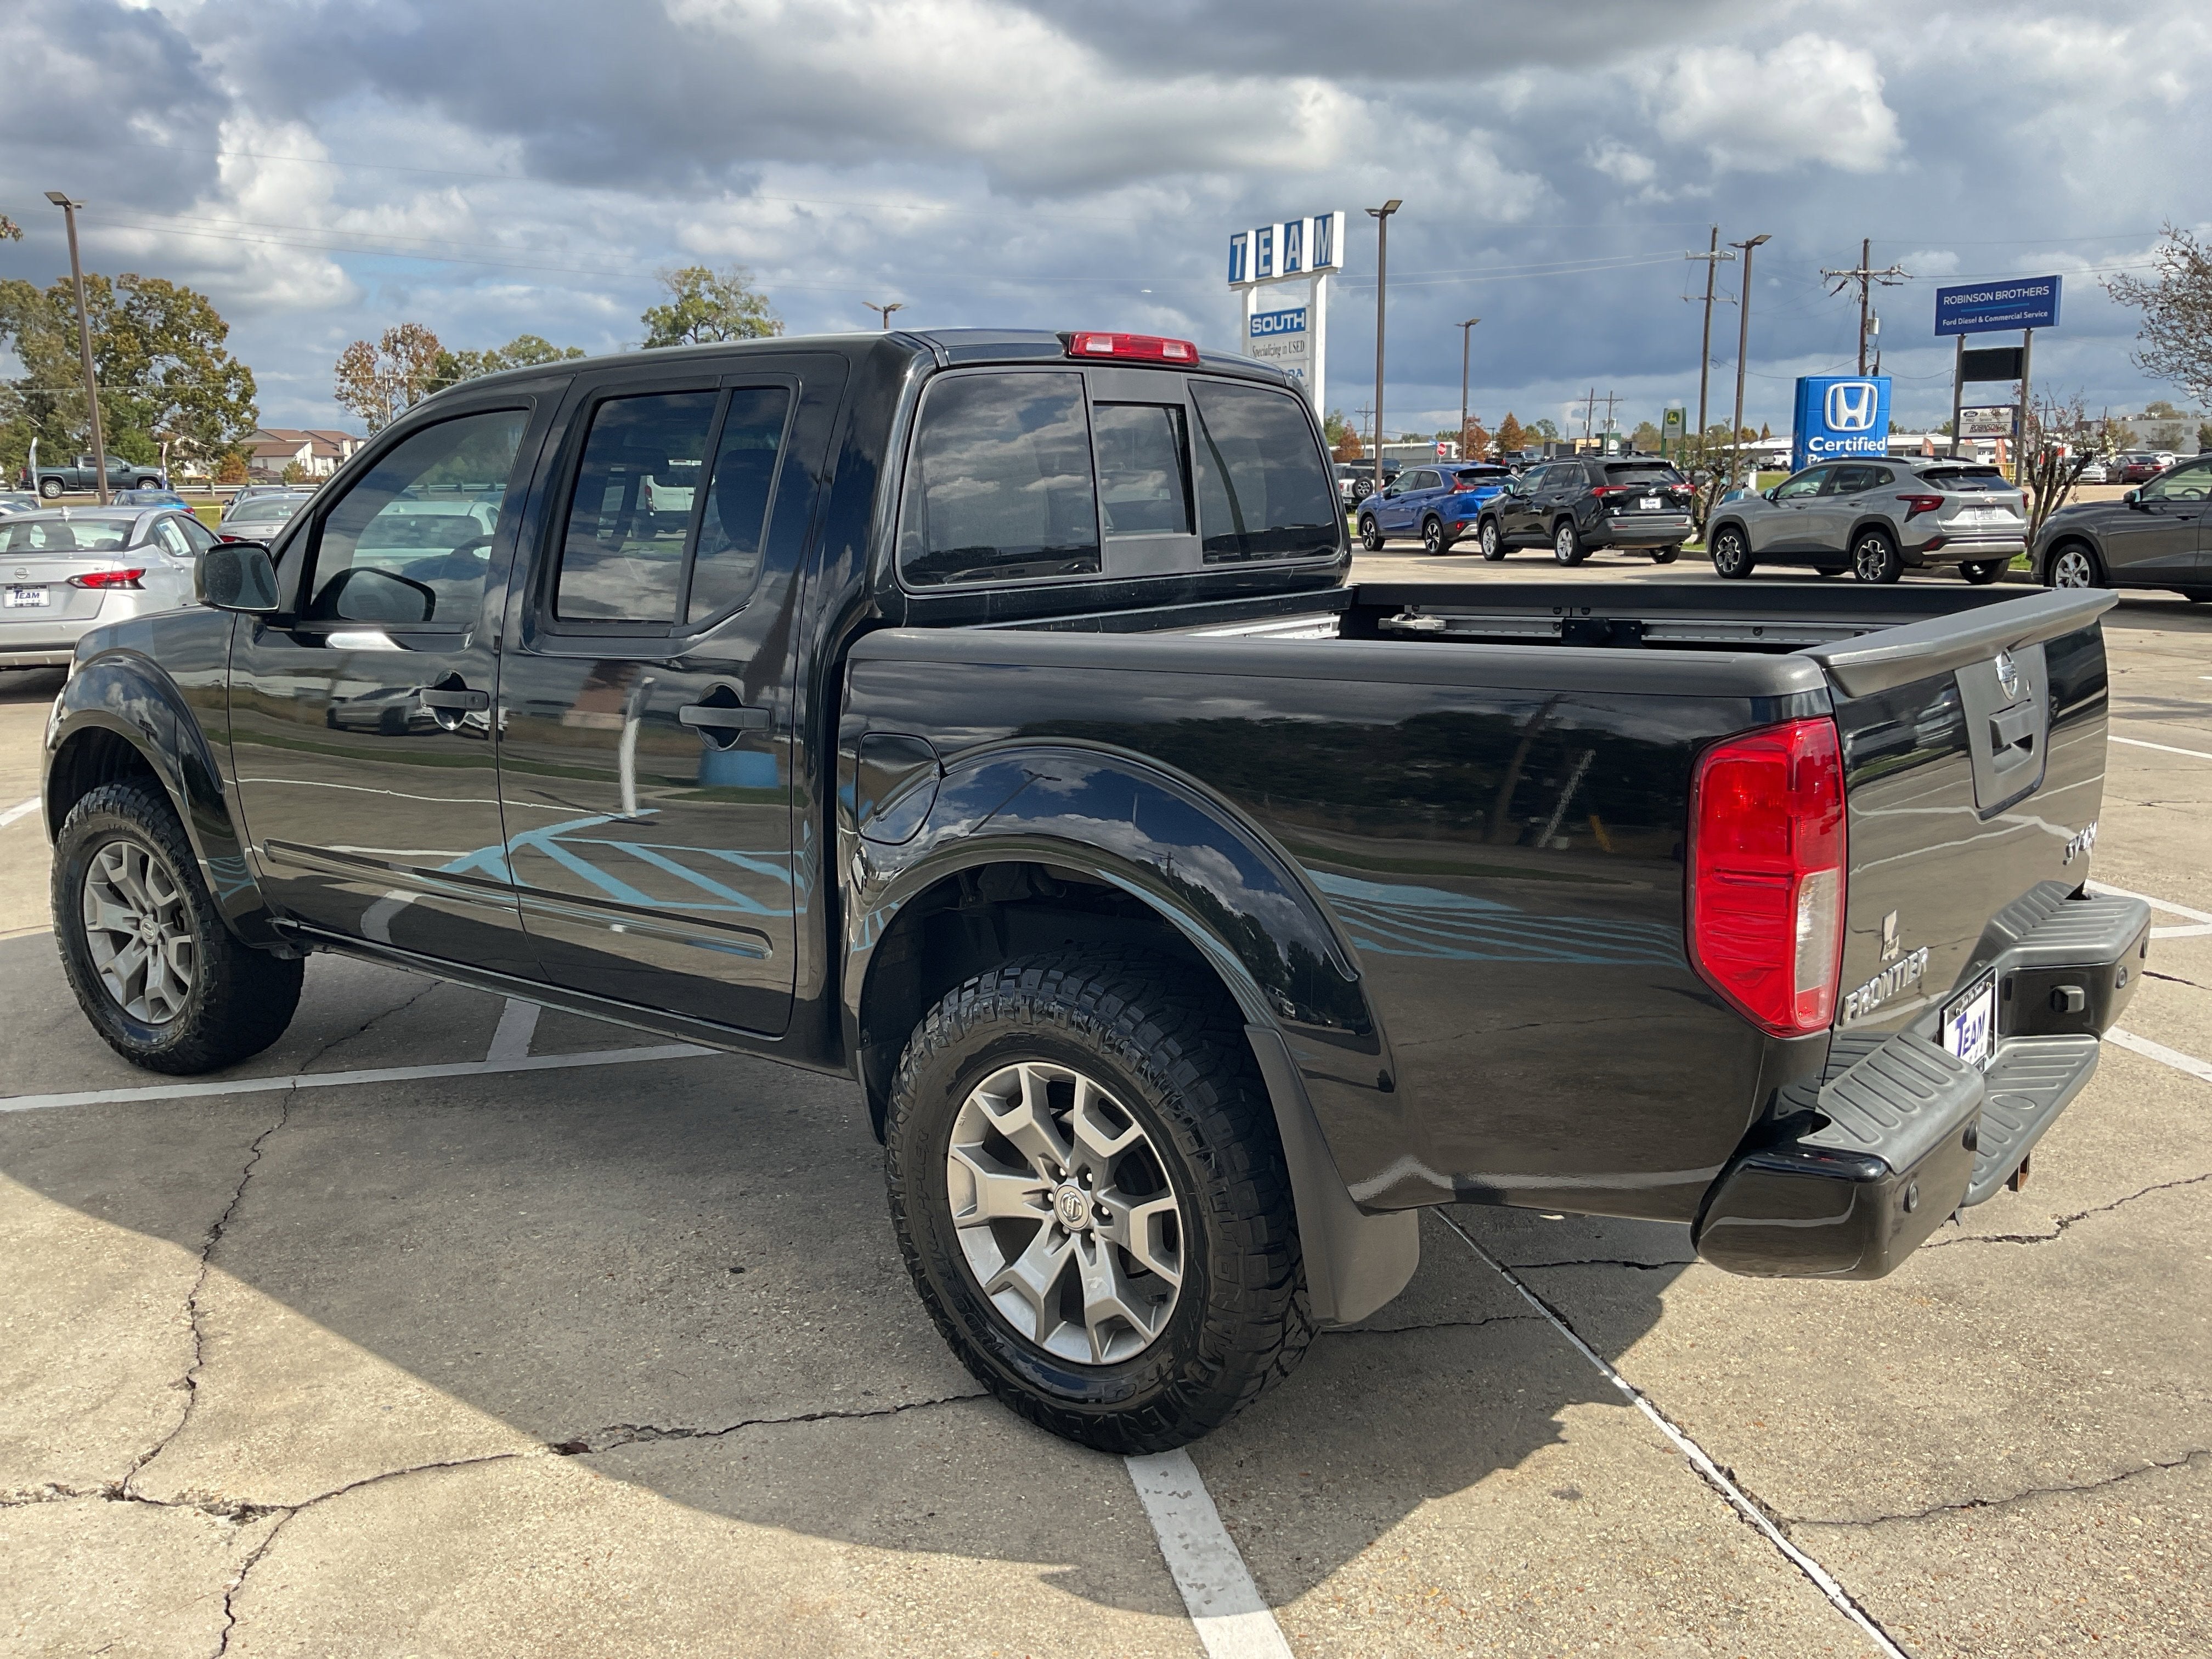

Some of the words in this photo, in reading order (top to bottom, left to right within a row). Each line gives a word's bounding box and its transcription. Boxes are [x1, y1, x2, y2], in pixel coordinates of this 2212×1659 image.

[1233, 217, 1333, 279] TEAM
[1943, 292, 1994, 305] ROBINSON
[1995, 285, 2050, 300] BROTHERS
[1252, 312, 1305, 334] SOUTH
[1984, 312, 2022, 322] Commercial
[2024, 310, 2048, 319] Service
[1252, 343, 1281, 358] Specializing
[1282, 342, 1287, 354] in
[1288, 340, 1305, 353] USED
[1808, 437, 1886, 452] Certified
[14, 589, 40, 599] TEAM
[1841, 946, 1928, 1025] FRONTIER
[1955, 1009, 1986, 1058] TEAM
